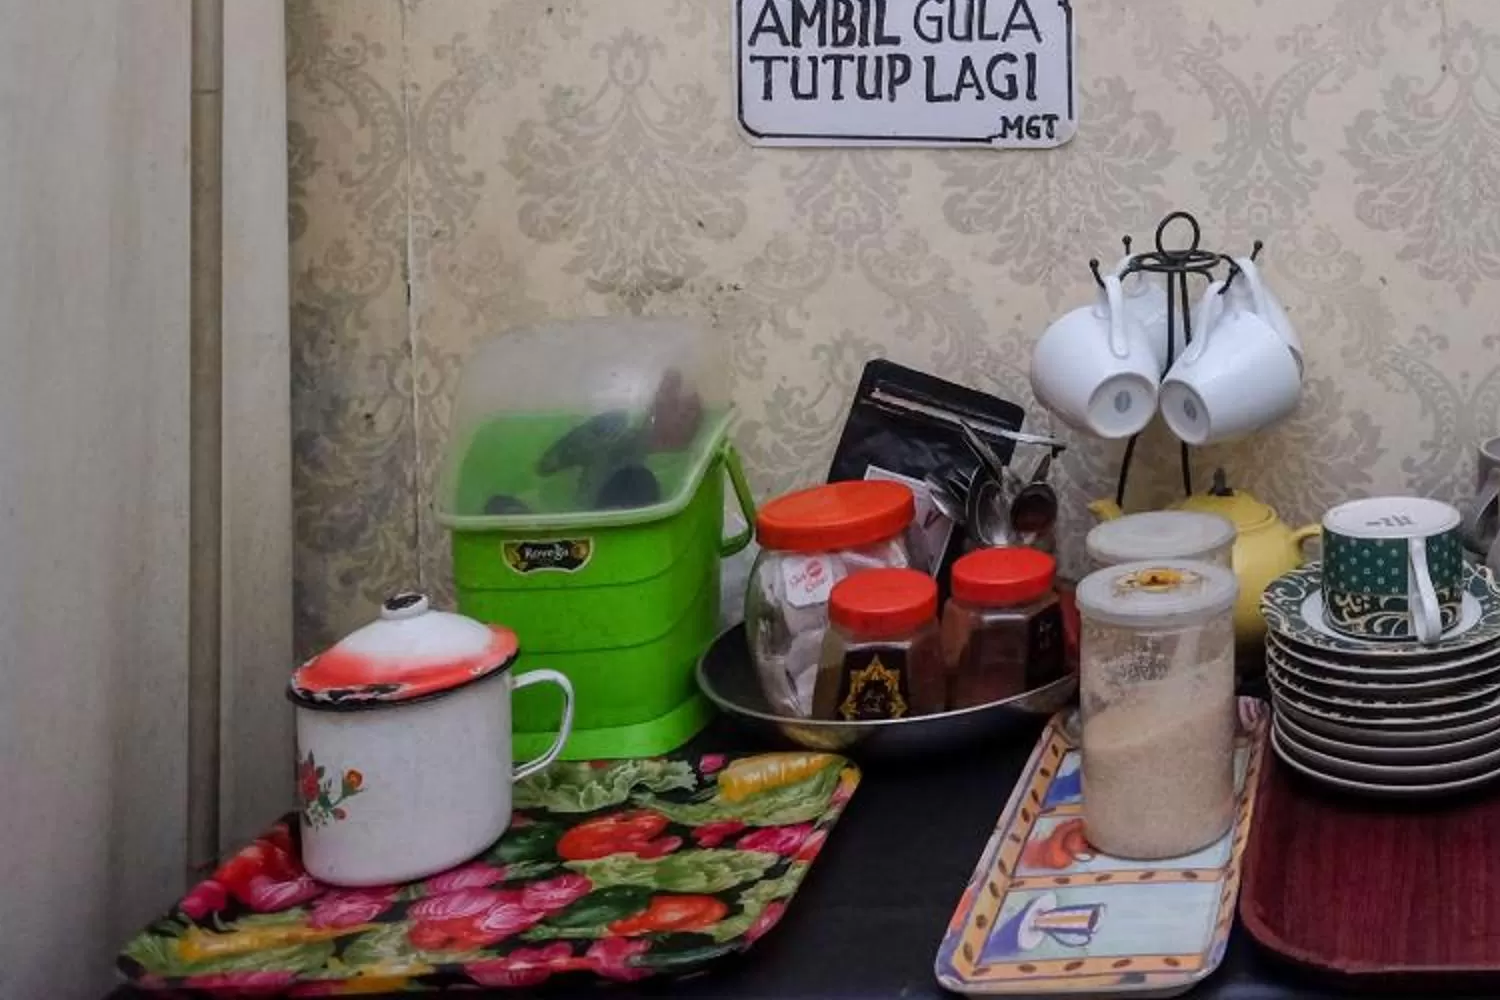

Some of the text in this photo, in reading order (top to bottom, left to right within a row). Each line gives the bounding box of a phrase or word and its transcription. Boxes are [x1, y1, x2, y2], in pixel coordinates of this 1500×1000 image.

[749, 52, 1038, 103] TUTUP LAGI
[1000, 113, 1060, 140] MGT
